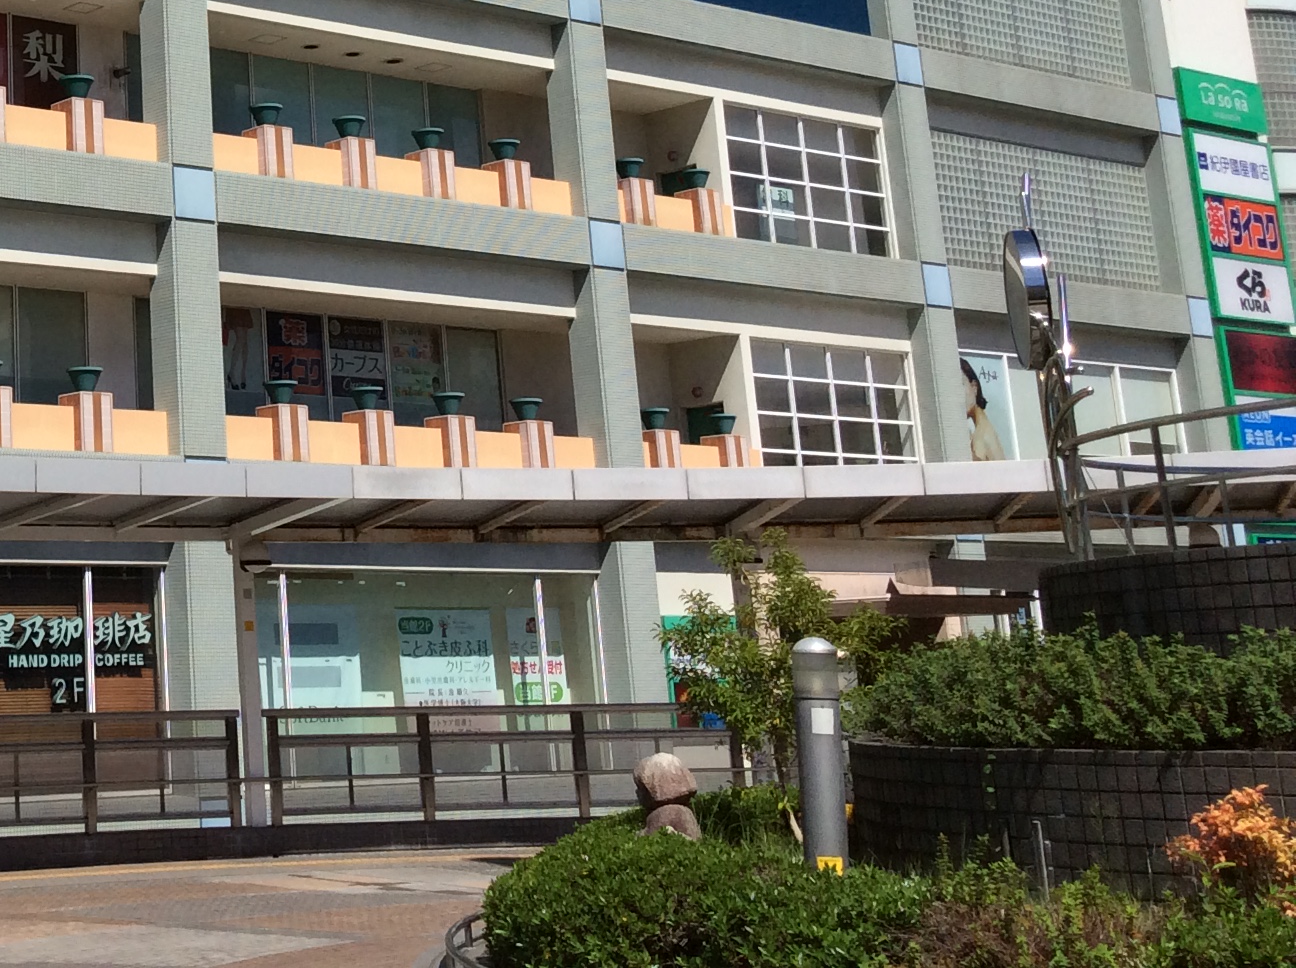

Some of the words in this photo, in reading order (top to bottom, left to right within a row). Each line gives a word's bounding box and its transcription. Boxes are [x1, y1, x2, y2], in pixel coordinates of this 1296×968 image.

[1239, 297, 1271, 315] KURA
[401, 639, 489, 657] ことぶき皮ふ科
[8, 654, 48, 668] HAND
[50, 654, 83, 668] DRIP
[95, 653, 144, 667] COFFEE
[446, 659, 490, 673] クリニック
